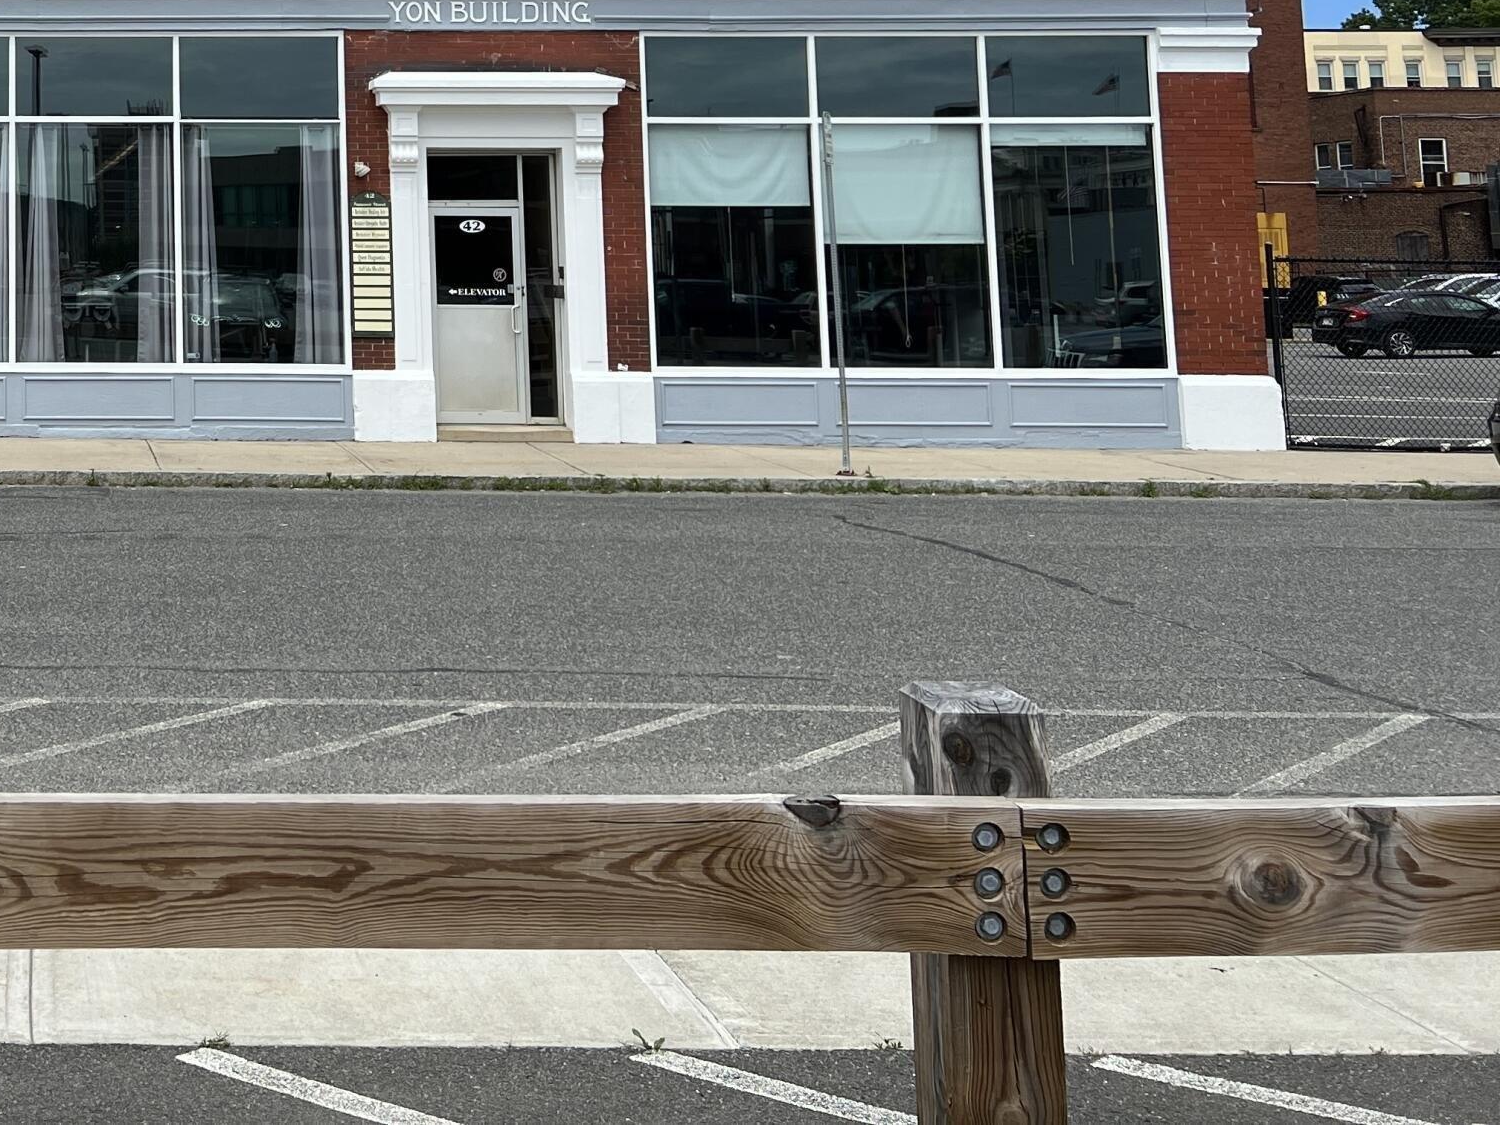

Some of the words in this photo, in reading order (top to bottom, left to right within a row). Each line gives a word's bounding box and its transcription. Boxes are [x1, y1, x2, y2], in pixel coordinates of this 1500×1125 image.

[388, 1, 442, 23] YON
[450, 1, 592, 24] BUILDING
[462, 221, 481, 232] 42
[457, 288, 506, 296] ELEVATOR
